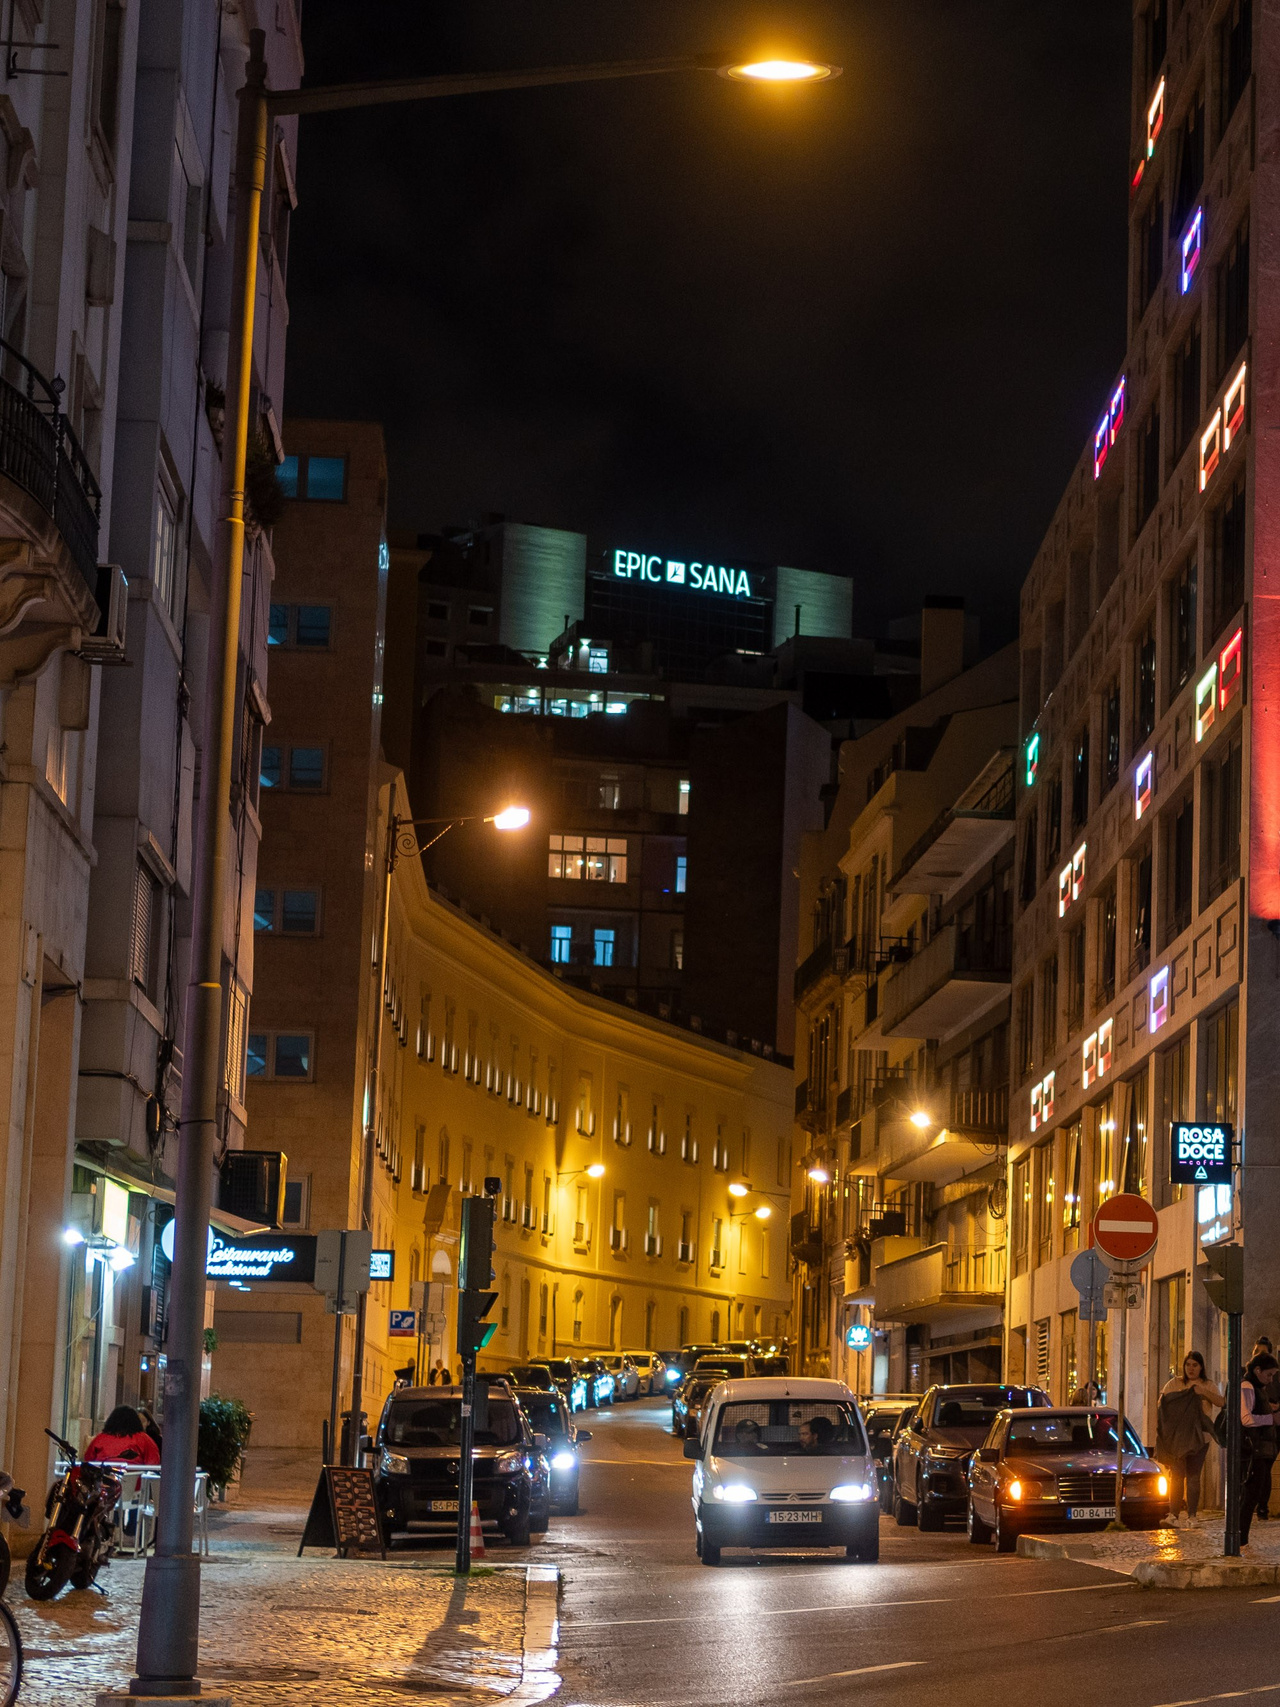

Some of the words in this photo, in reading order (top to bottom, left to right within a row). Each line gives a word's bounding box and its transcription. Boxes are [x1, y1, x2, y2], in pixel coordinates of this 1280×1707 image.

[615, 549, 662, 583] EPIC
[689, 561, 751, 597] SANA
[1179, 1127, 1224, 1143] ROSA
[1179, 1143, 1225, 1159] DOCE
[206, 1260, 273, 1276] radicional
[391, 1312, 402, 1326] P
